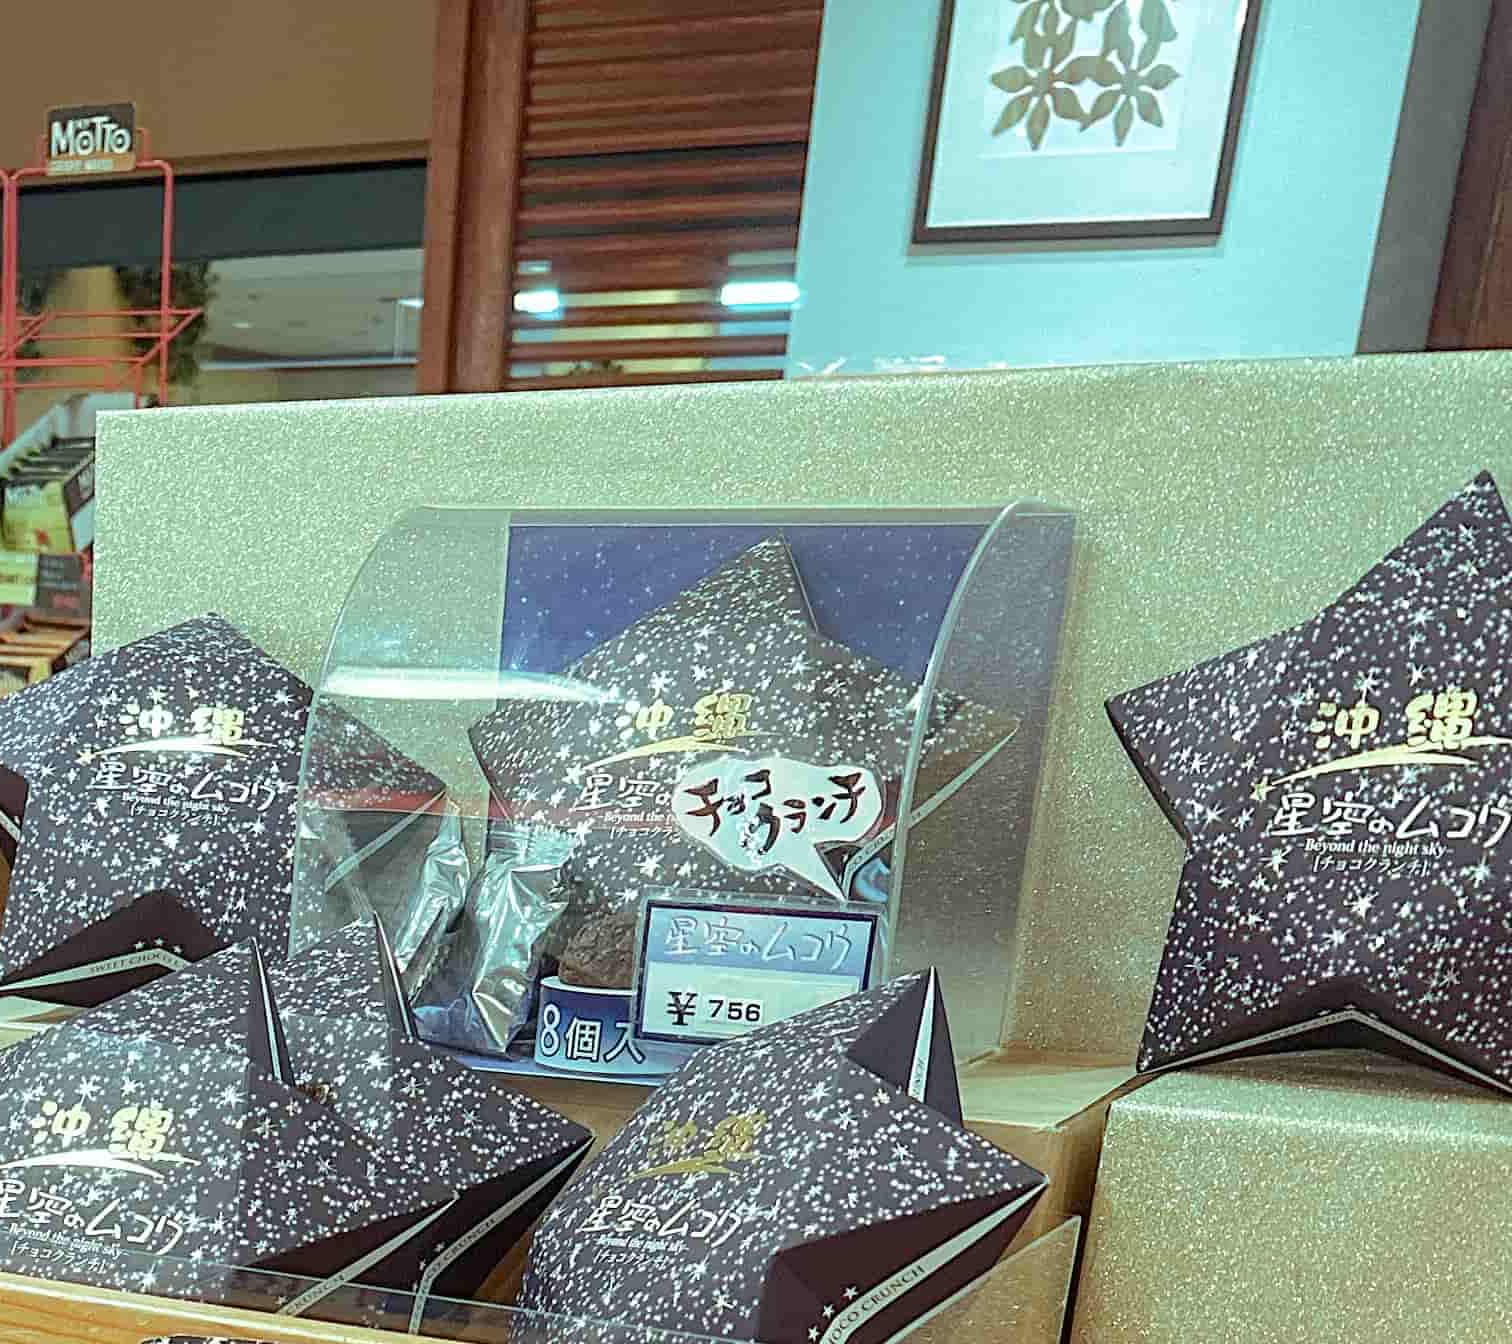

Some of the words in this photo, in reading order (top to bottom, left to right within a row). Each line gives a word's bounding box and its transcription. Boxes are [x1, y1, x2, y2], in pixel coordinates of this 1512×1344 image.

[119, 704, 245, 745] 沖縄
[621, 696, 754, 738] 沖縄
[1310, 690, 1477, 751] 沖縄
[86, 762, 276, 810] 星空のムコウ
[1271, 793, 1512, 850] 星空のムコウ
[663, 916, 854, 970] 星空のムコウ
[710, 999, 761, 1022] 756
[32, 1101, 173, 1154] 沖縄
[649, 1112, 768, 1157] 沖縄
[580, 1195, 743, 1246] 星空のムコウ
